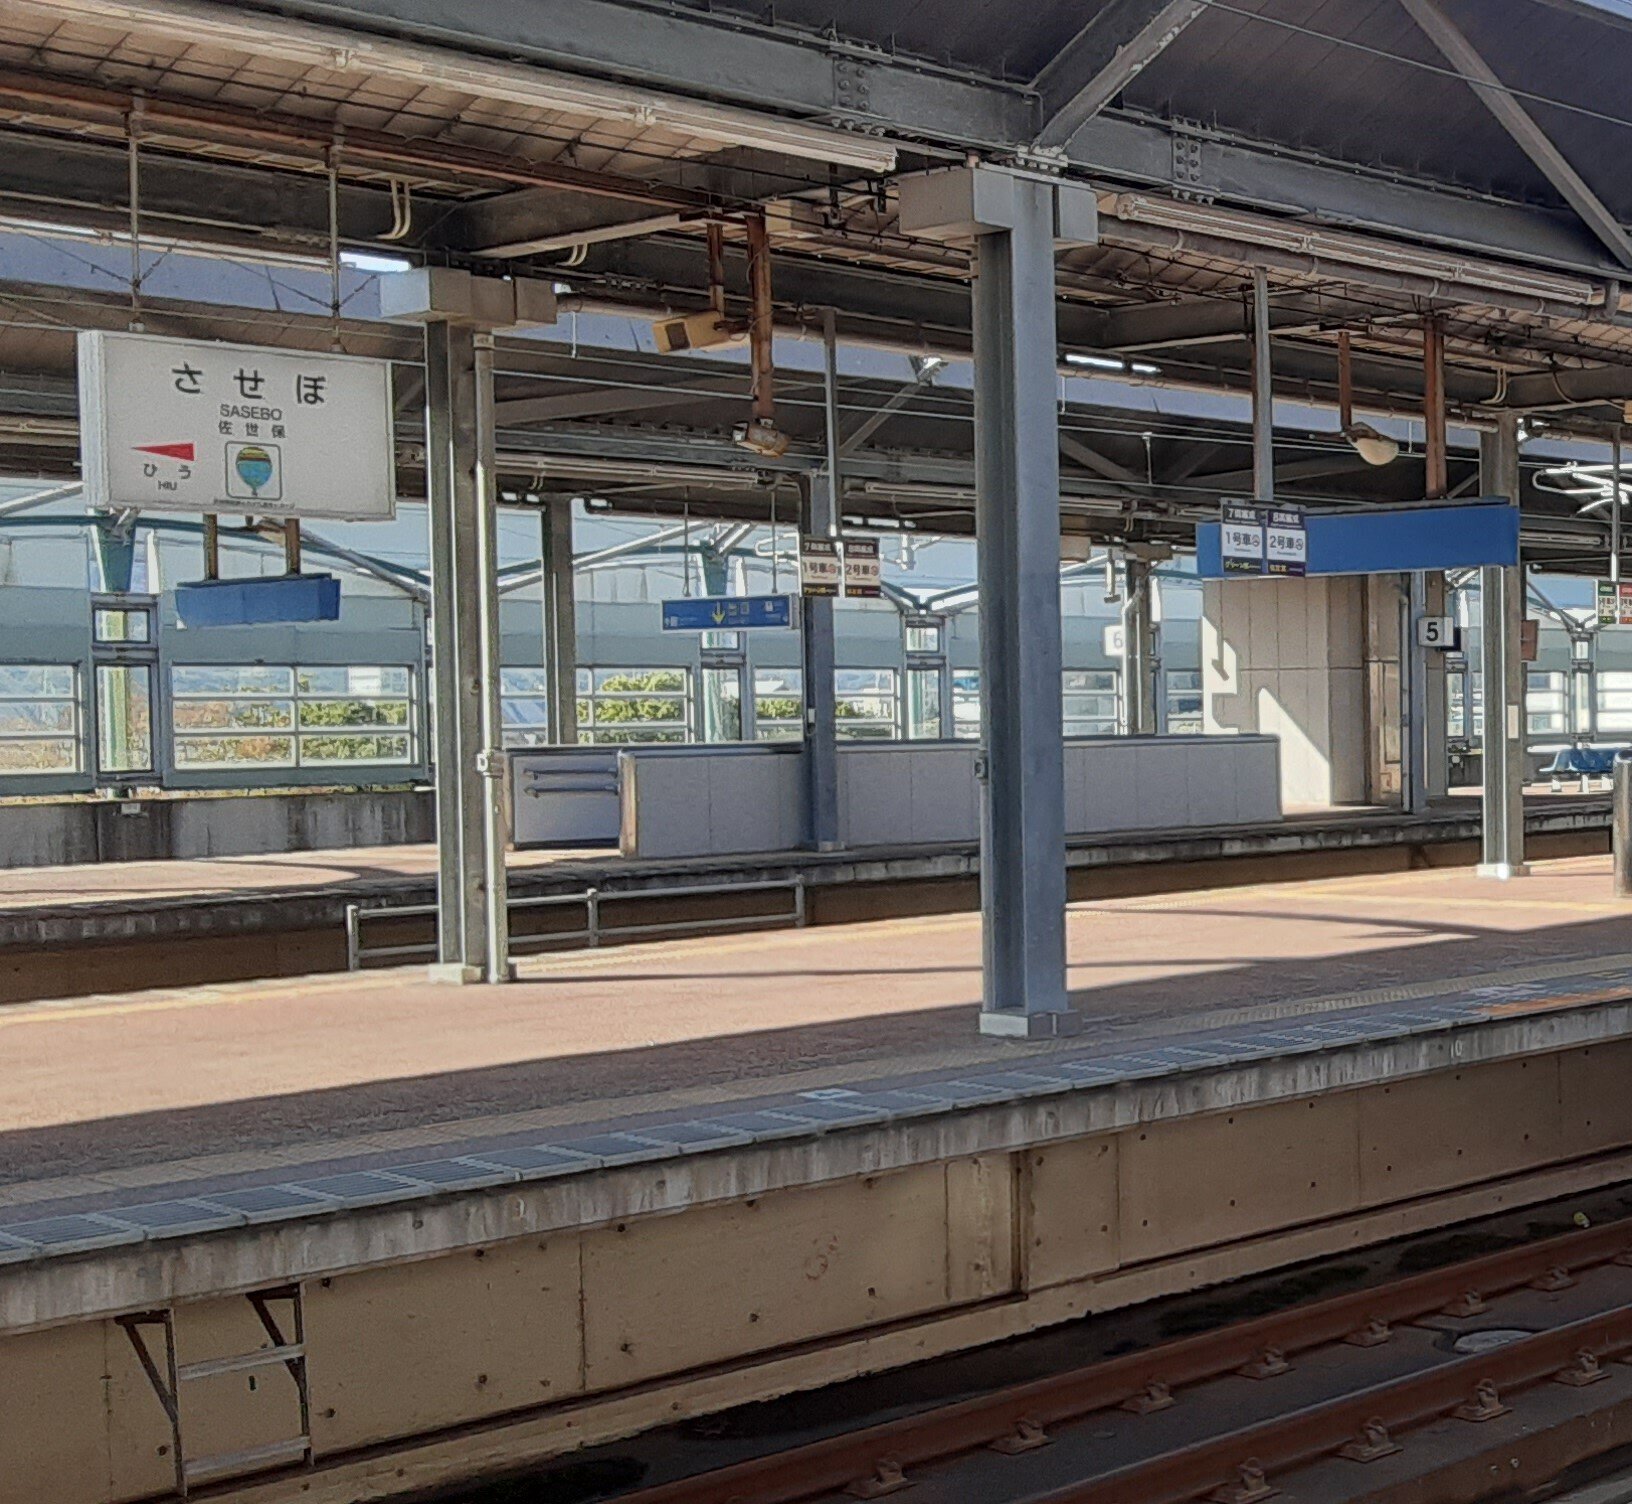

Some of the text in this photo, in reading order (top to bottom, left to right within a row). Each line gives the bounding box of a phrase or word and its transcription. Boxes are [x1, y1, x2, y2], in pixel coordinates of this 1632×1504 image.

[171, 361, 327, 405] させぼ
[219, 403, 282, 420] SASEBO
[217, 420, 287, 438] 佐世保
[143, 462, 191, 480] ひう
[1113, 631, 1123, 649] 6
[1426, 621, 1439, 642] 5
